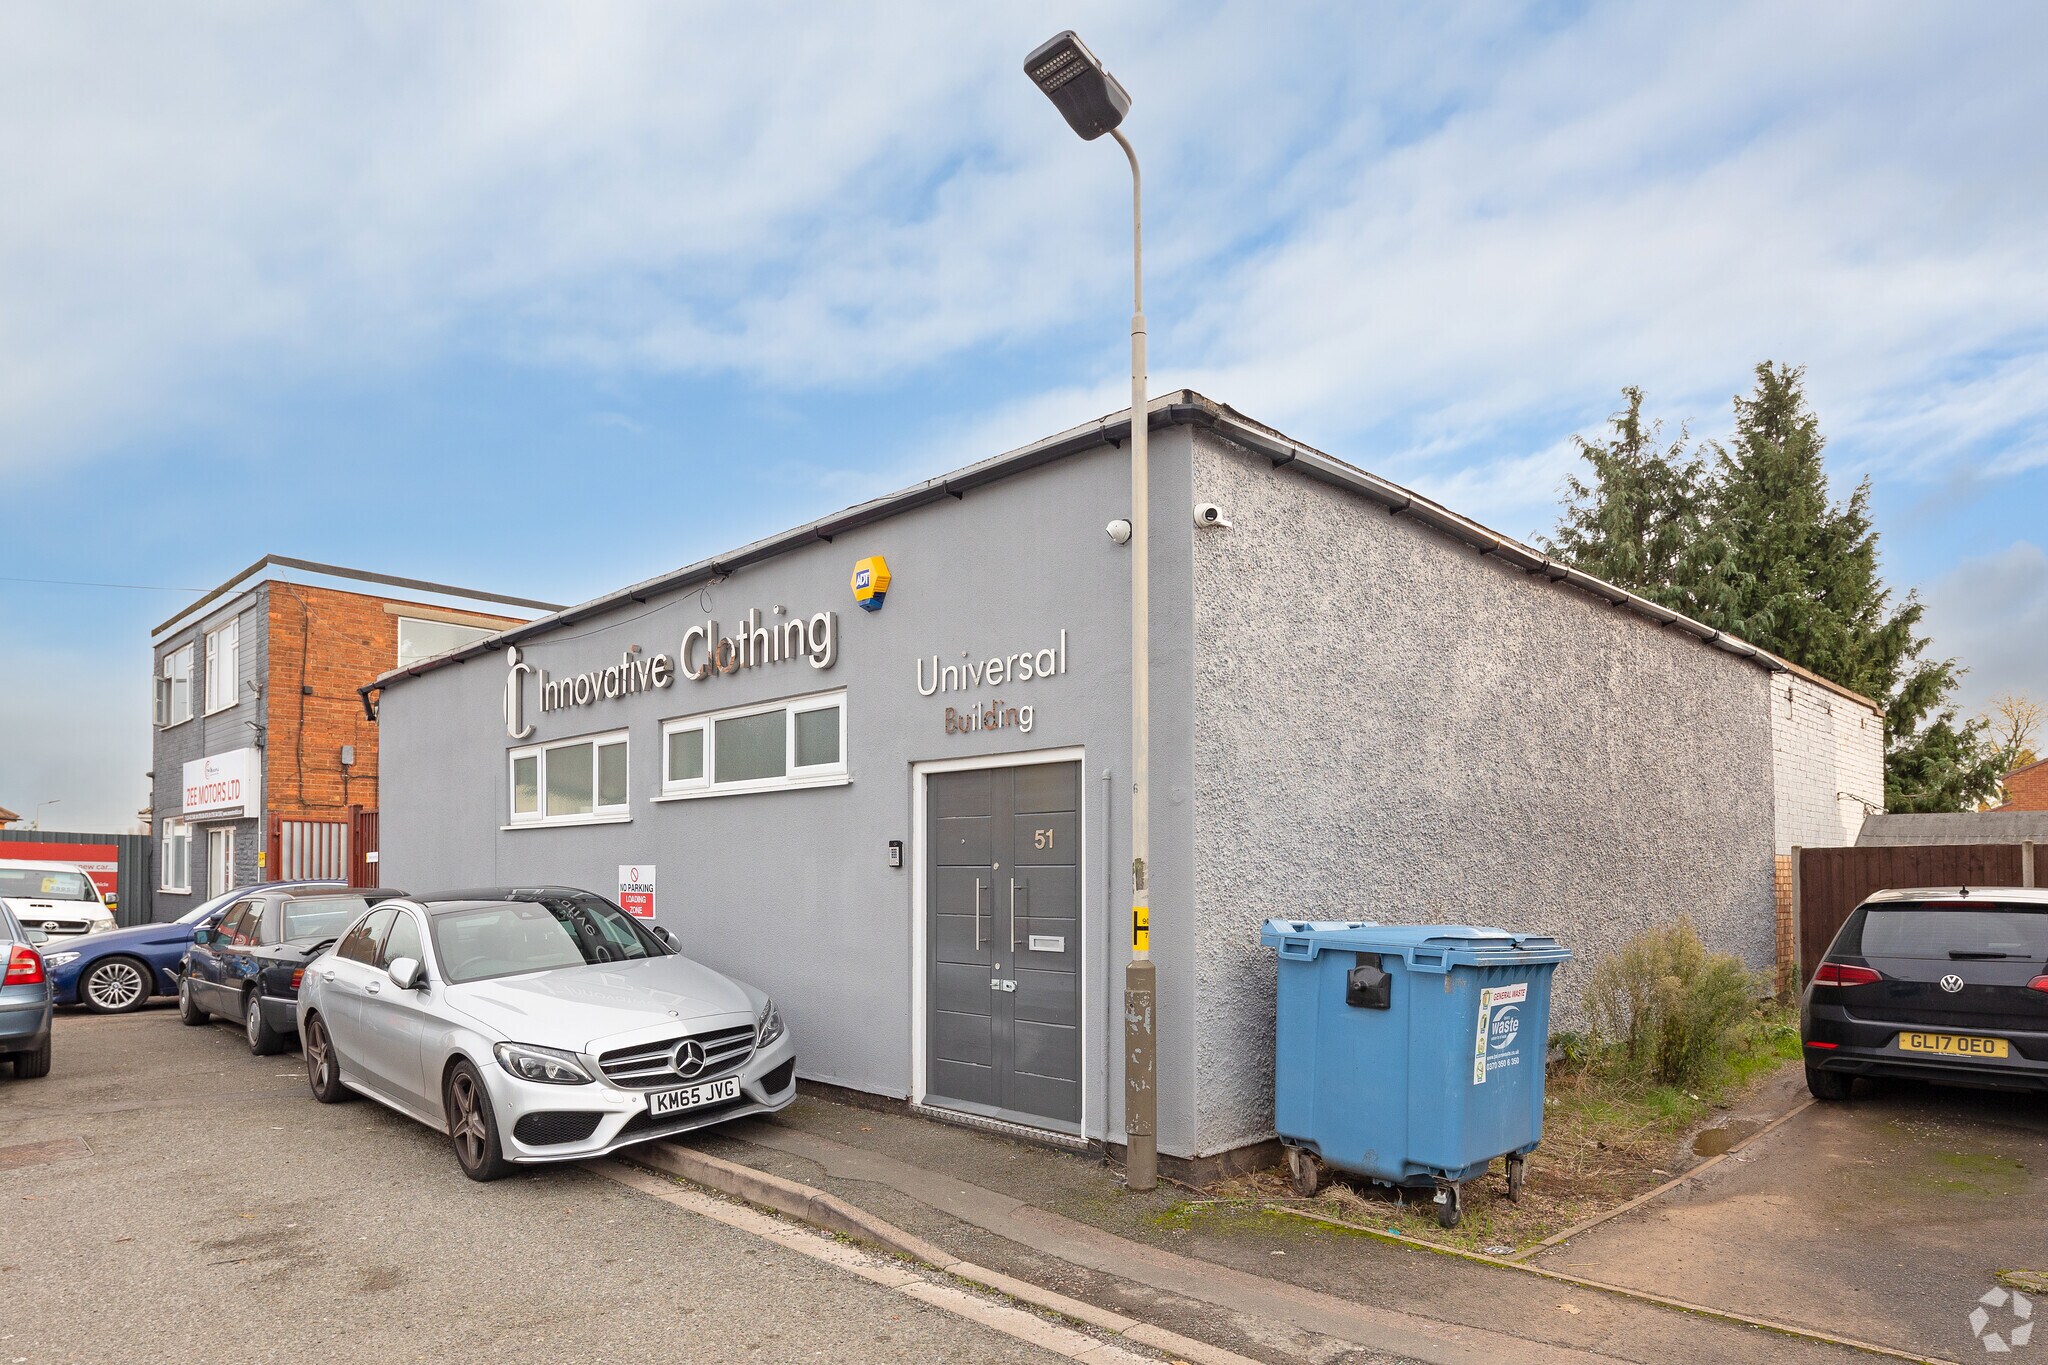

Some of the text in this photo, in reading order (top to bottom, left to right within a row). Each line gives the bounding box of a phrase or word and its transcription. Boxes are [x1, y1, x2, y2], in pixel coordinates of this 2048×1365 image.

[856, 571, 870, 588] ADT
[539, 604, 837, 712] Innovative Clothing
[917, 628, 1067, 696] Universal
[945, 699, 1034, 734] Building
[186, 778, 241, 807] ZEE MOTORS LTD
[1034, 829, 1054, 850] 51
[620, 884, 654, 892] NO PARKING
[629, 906, 643, 914] ZONE
[1493, 988, 1526, 1001] GENERAL WASTE
[1492, 1017, 1519, 1035] waste
[1911, 1034, 1952, 1050] GL17
[657, 1080, 734, 1112] KM65 JVG
